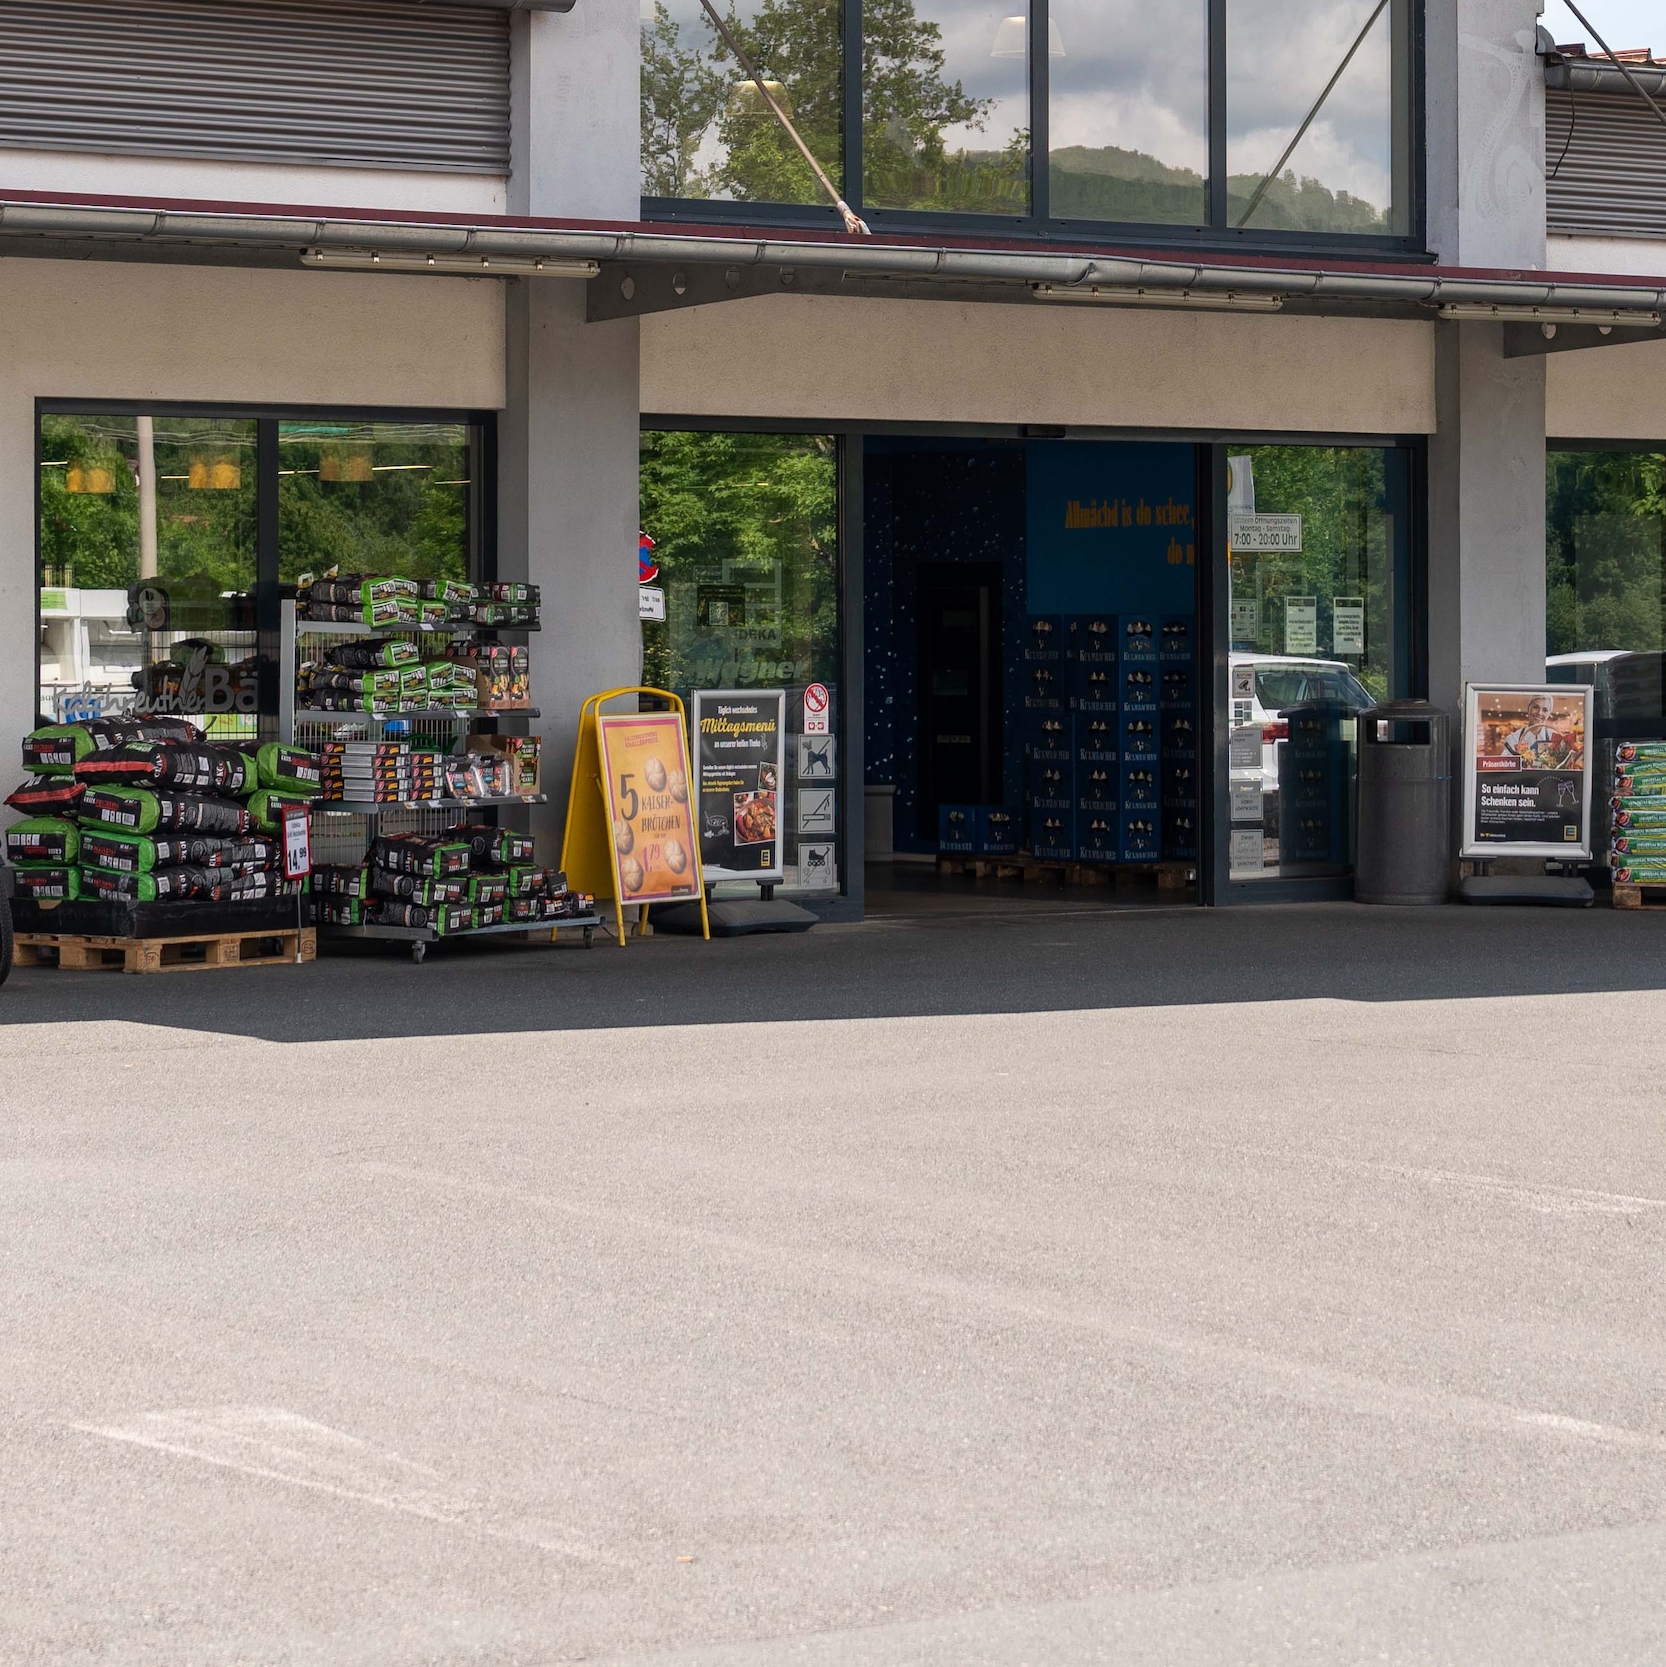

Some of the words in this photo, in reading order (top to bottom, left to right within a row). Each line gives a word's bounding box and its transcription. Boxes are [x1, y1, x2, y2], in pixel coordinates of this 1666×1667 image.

[1122, 499, 1132, 526] is
[1136, 498, 1151, 525] do
[1255, 516, 1297, 525] Öffnungszeiten
[1240, 525, 1261, 533] Montag
[1234, 533, 1251, 545] 7:00
[1259, 533, 1280, 545] 20:00
[1282, 533, 1297, 545] Uhr
[1167, 537, 1182, 564] do
[53, 675, 206, 714] Kalchreuther
[700, 717, 776, 738] Mittagsmenü
[1483, 760, 1517, 769] Präsentkörbe
[620, 773, 639, 821] 5
[1481, 783, 1491, 794] So
[1493, 784, 1520, 795] einfach
[1521, 785, 1540, 795] kann
[641, 794, 674, 811] KAISER-
[1481, 795, 1516, 807] Schenken
[1518, 797, 1536, 808] sein.
[641, 814, 681, 833] BRÖTCHEN
